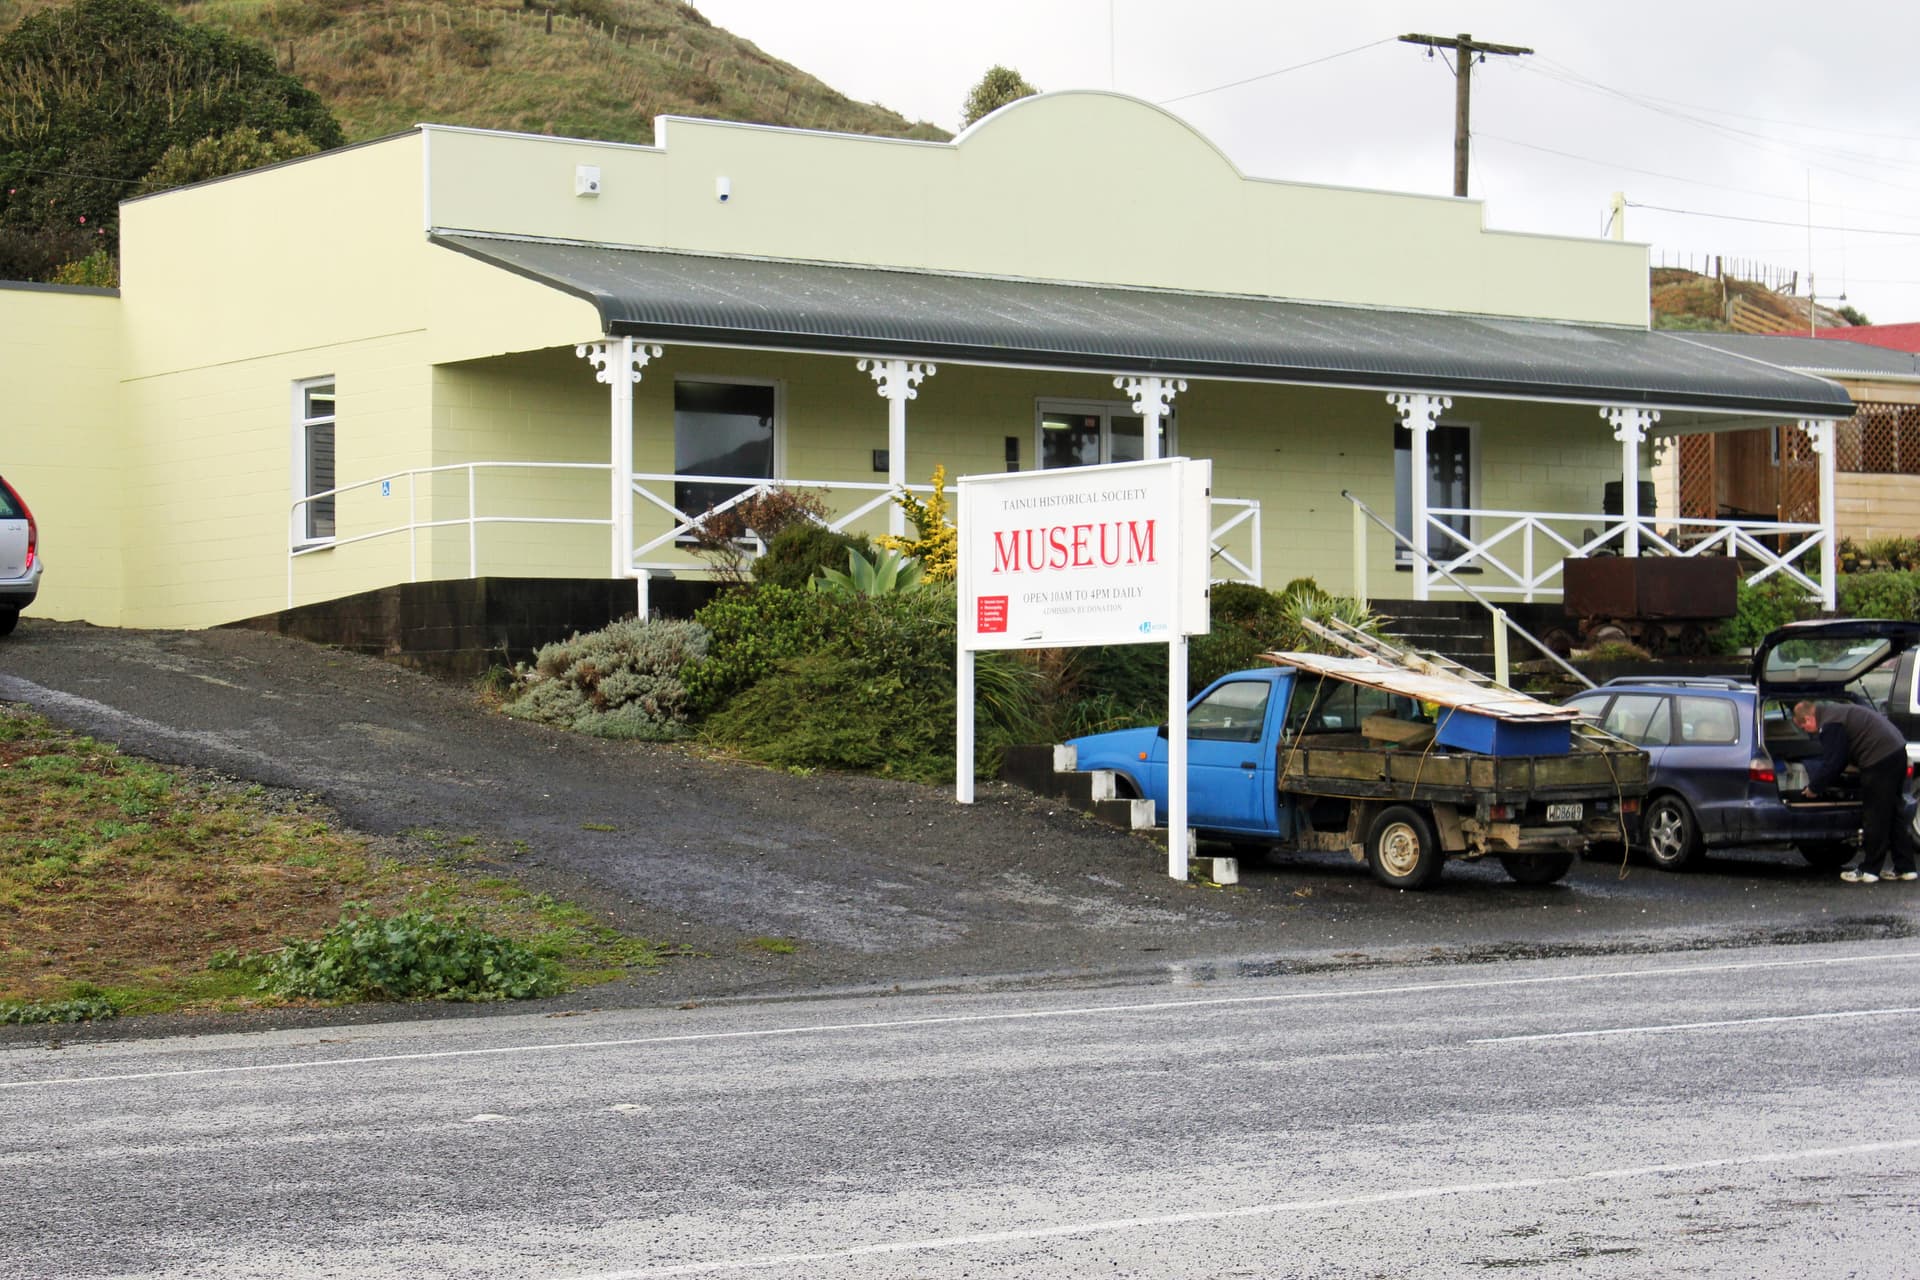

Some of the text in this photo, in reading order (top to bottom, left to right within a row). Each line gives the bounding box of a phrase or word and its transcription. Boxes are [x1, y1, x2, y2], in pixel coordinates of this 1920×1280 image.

[1002, 488, 1147, 511] TAINUI HISTORICAL SOCIETY
[992, 519, 1158, 573] MUSEUM
[1023, 586, 1144, 603] OPEN 10AM TO 4PM DAILY
[1087, 602, 1123, 613] DONATION
